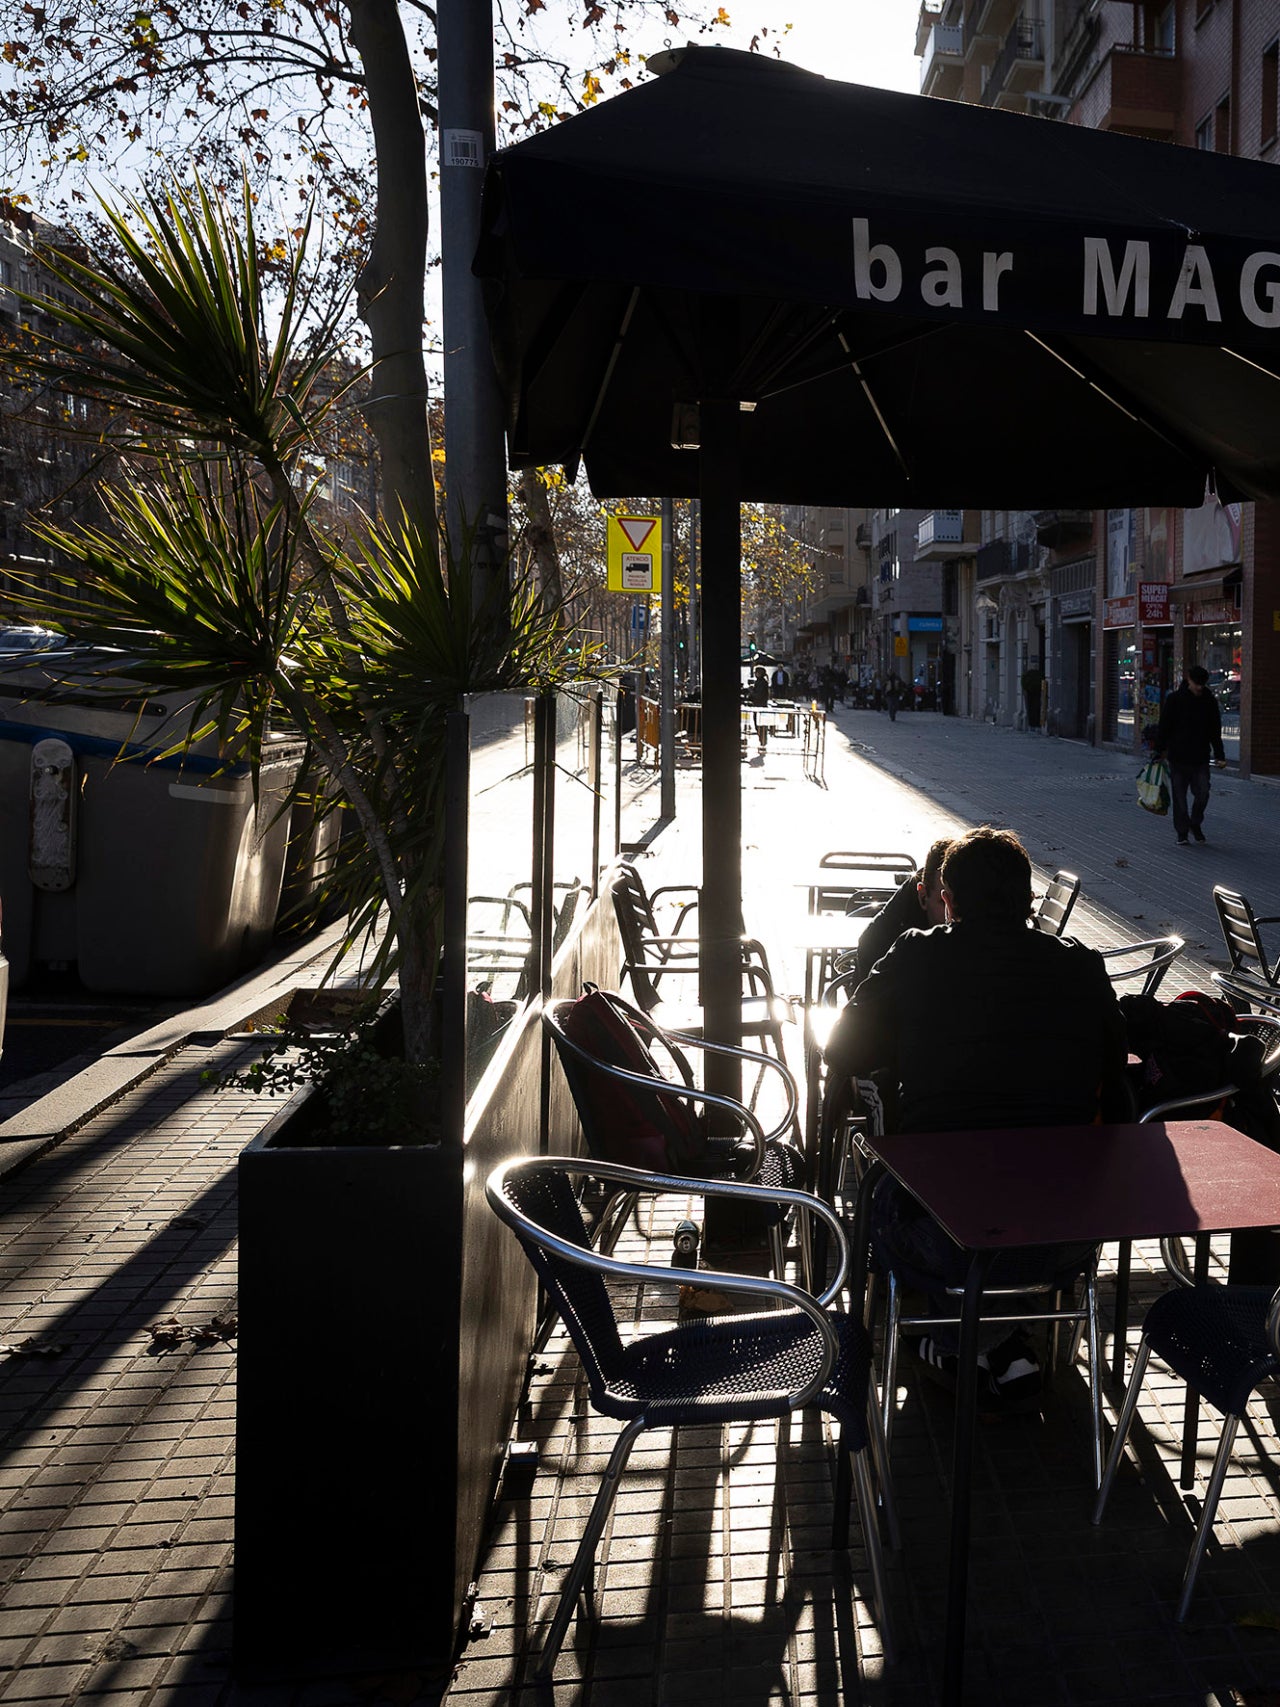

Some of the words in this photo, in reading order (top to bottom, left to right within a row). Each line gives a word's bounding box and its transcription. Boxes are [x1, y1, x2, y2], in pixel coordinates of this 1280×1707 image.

[451, 158, 479, 166] 190775
[852, 217, 1013, 311] bar
[1141, 584, 1167, 594] SUPER
[1146, 609, 1163, 618] 24h
